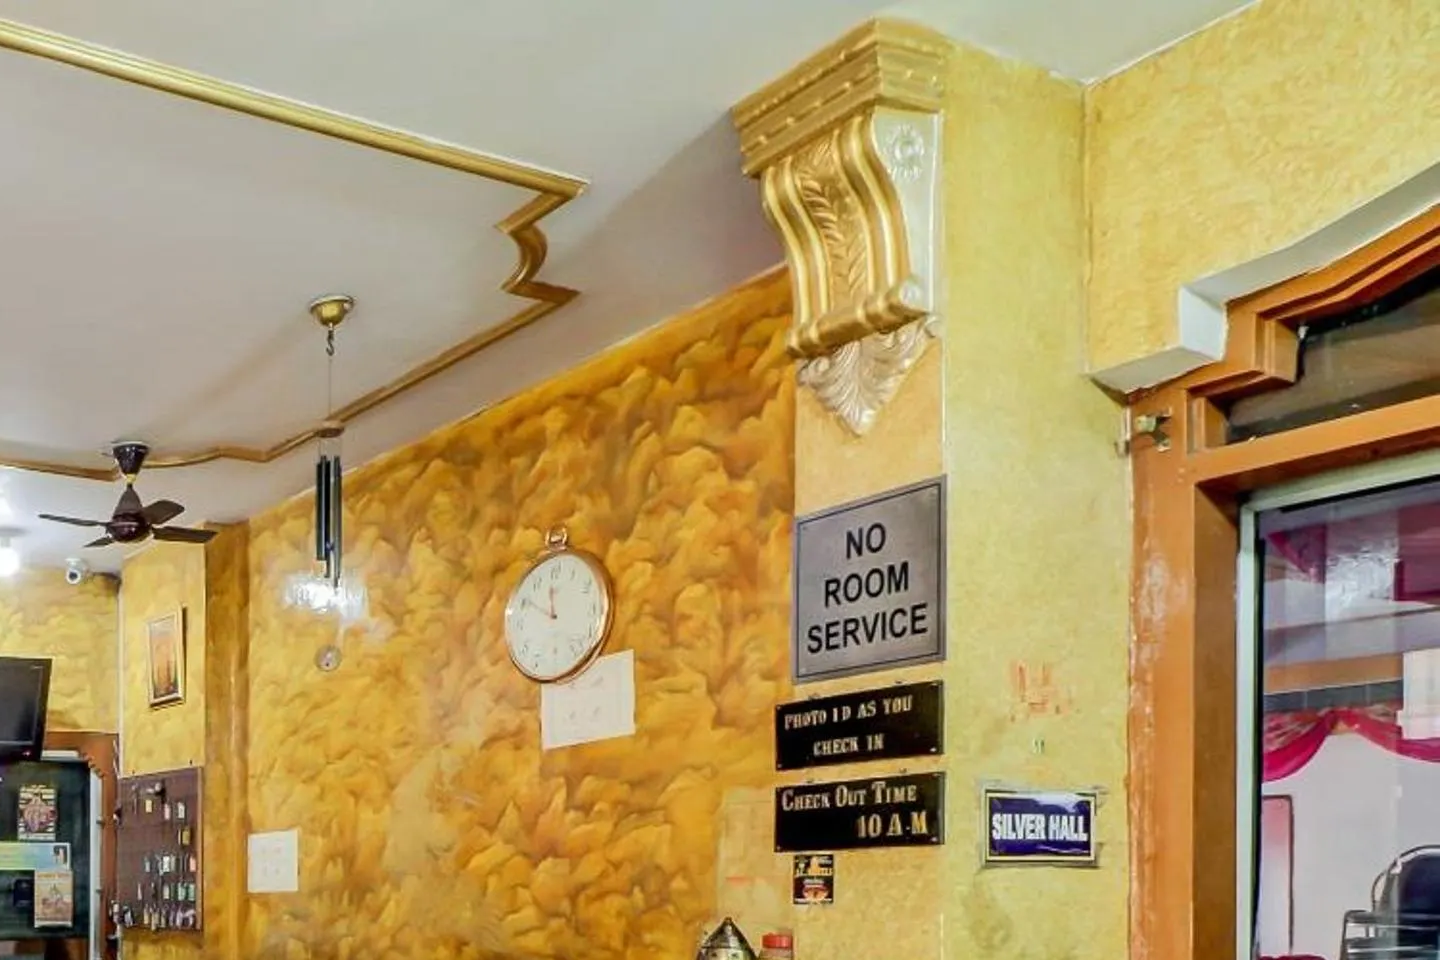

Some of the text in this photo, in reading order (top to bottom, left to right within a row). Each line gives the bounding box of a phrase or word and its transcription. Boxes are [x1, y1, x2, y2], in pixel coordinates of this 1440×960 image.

[846, 522, 886, 559] NO
[824, 560, 909, 608] ROOM
[807, 602, 928, 654] SERVICE
[784, 709, 827, 730] PHOTO
[857, 699, 877, 719] AS
[882, 694, 913, 715] YOU
[813, 732, 884, 757] CHECK IN
[857, 812, 882, 838] 10
[991, 813, 1088, 842] SILVER HALL
